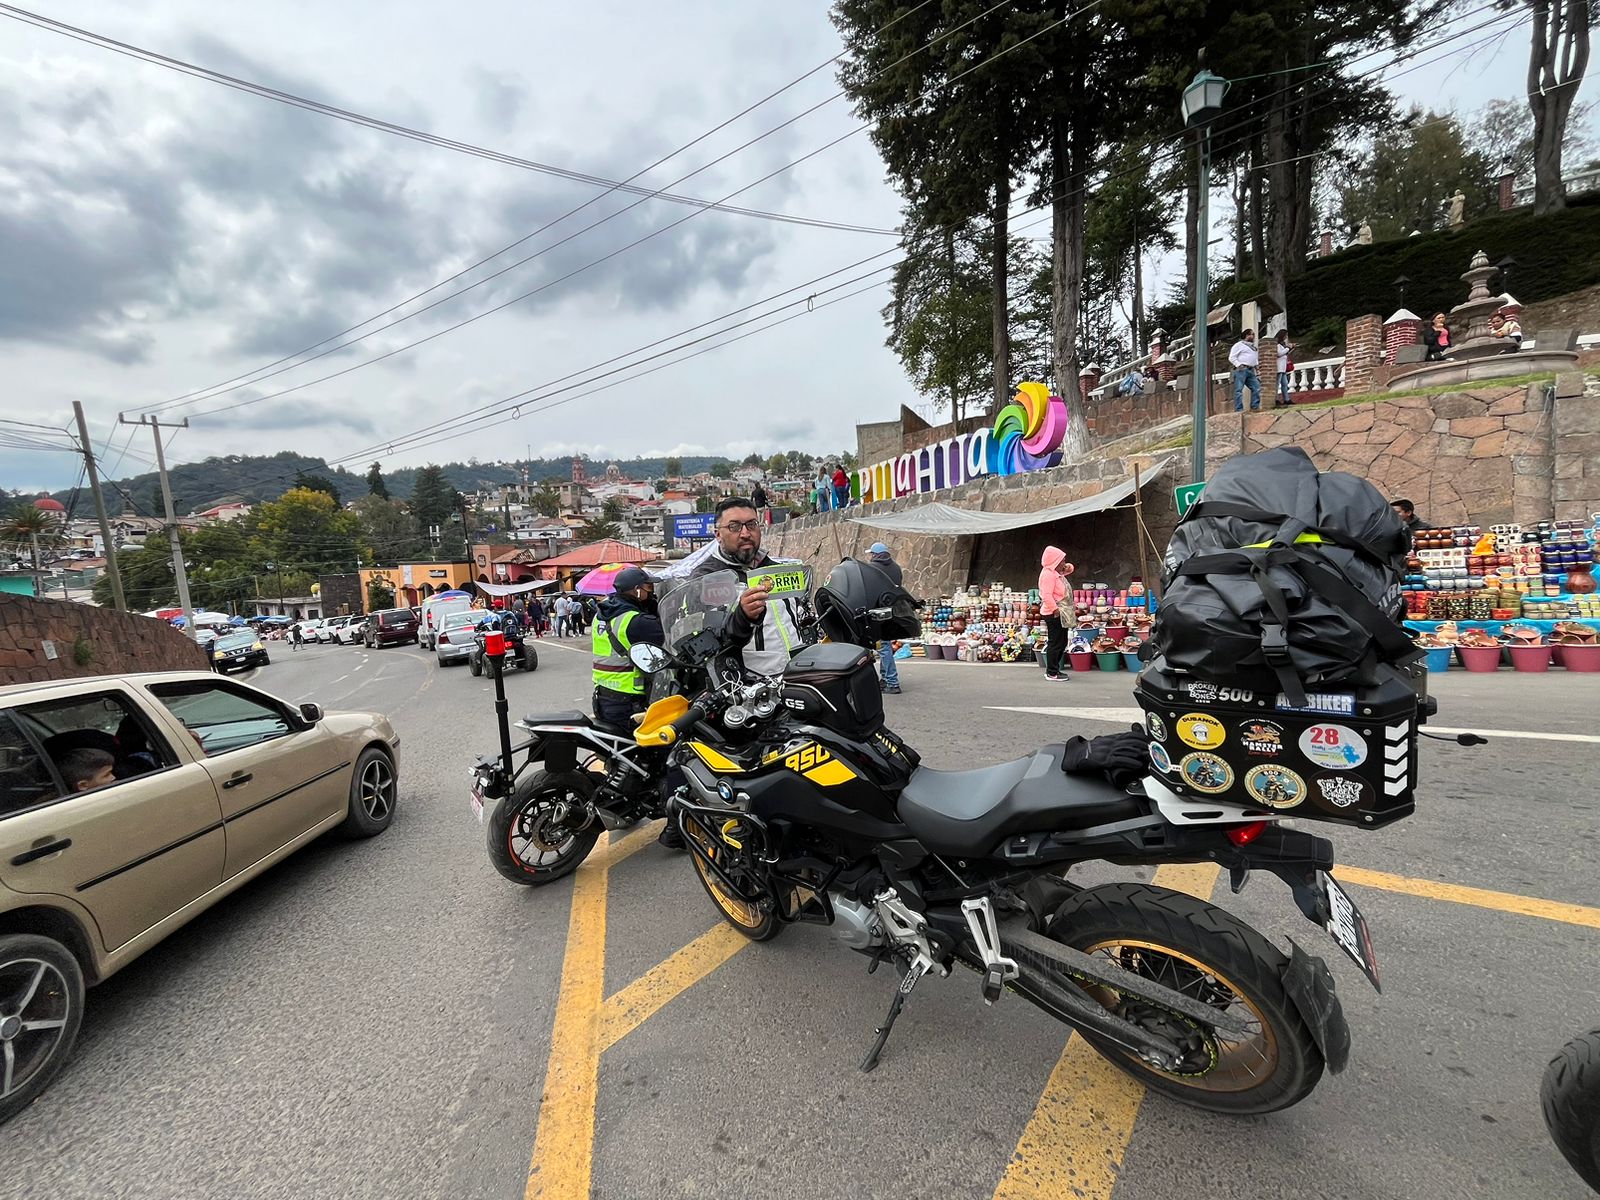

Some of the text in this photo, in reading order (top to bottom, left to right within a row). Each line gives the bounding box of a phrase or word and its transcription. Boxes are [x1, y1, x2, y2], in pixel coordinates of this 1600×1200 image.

[775, 576, 800, 588] RRM
[1188, 683, 1218, 692] BROKEN
[1189, 691, 1217, 699] BONES
[1218, 687, 1254, 702] 500
[785, 698, 805, 710] GS
[1310, 727, 1340, 745] 28
[1248, 745, 1277, 753] RALLY
